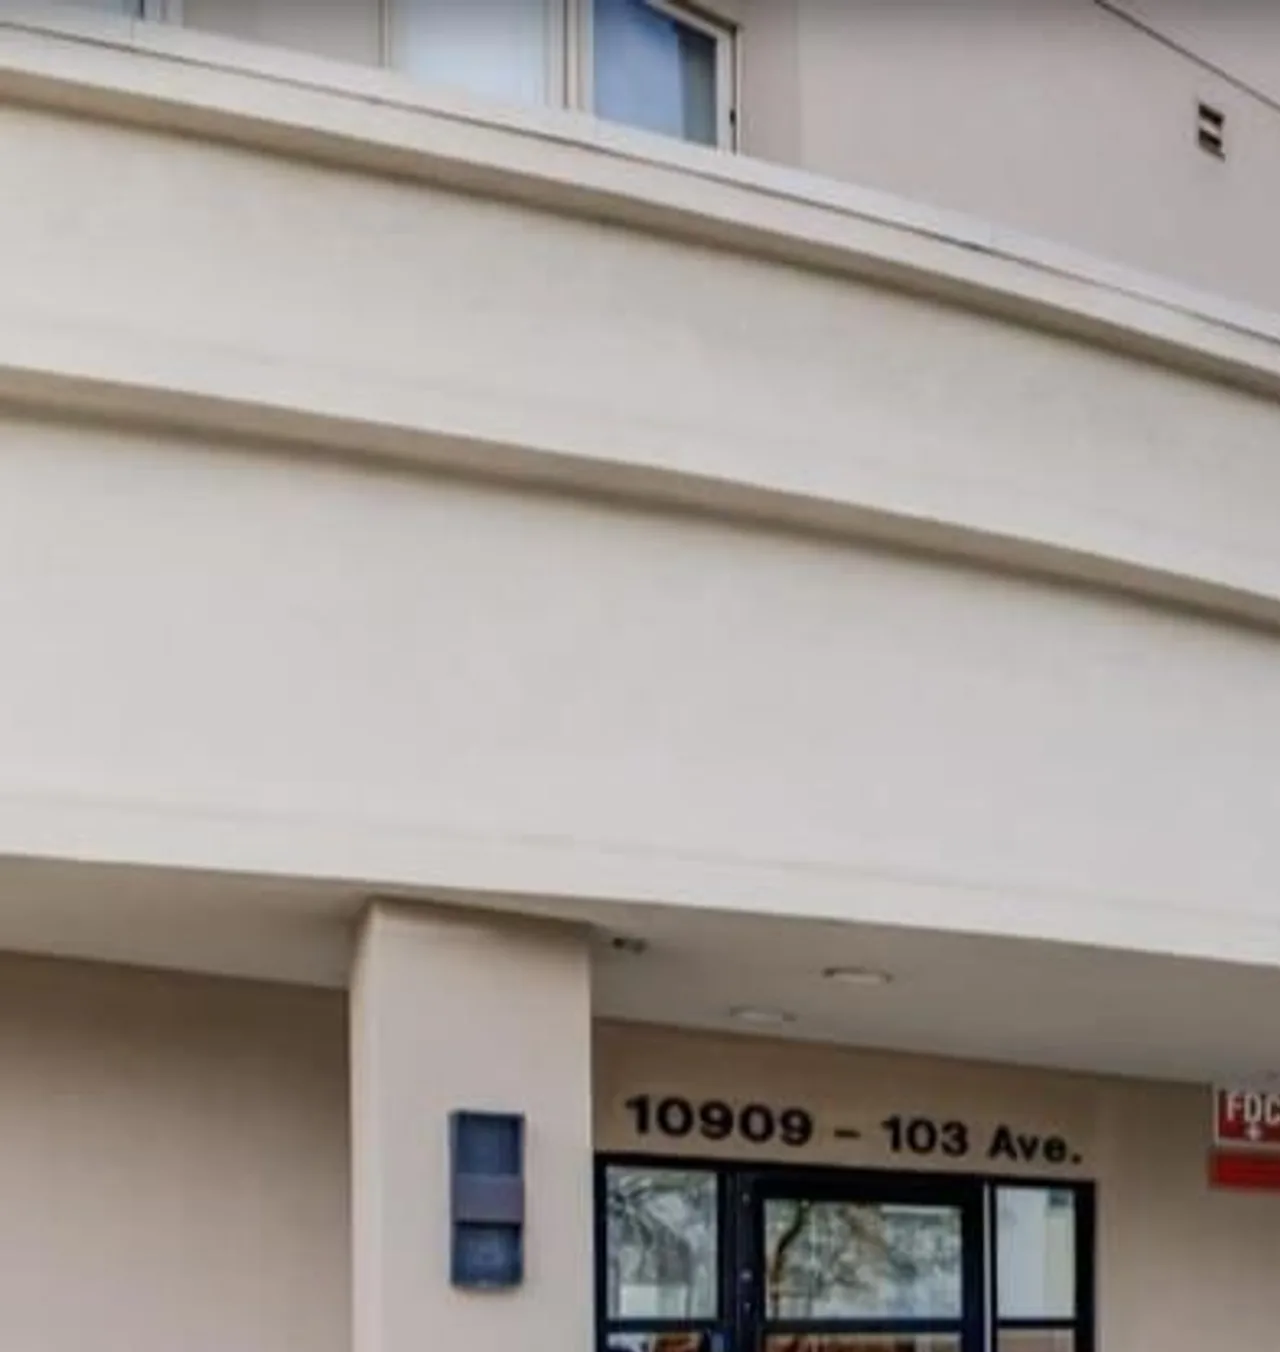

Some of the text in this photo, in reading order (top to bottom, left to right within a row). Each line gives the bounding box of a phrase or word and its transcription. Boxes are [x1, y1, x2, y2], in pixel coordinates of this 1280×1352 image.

[625, 1094, 814, 1147] 10909
[881, 1115, 969, 1158] 103
[987, 1125, 1083, 1165] Ave.
